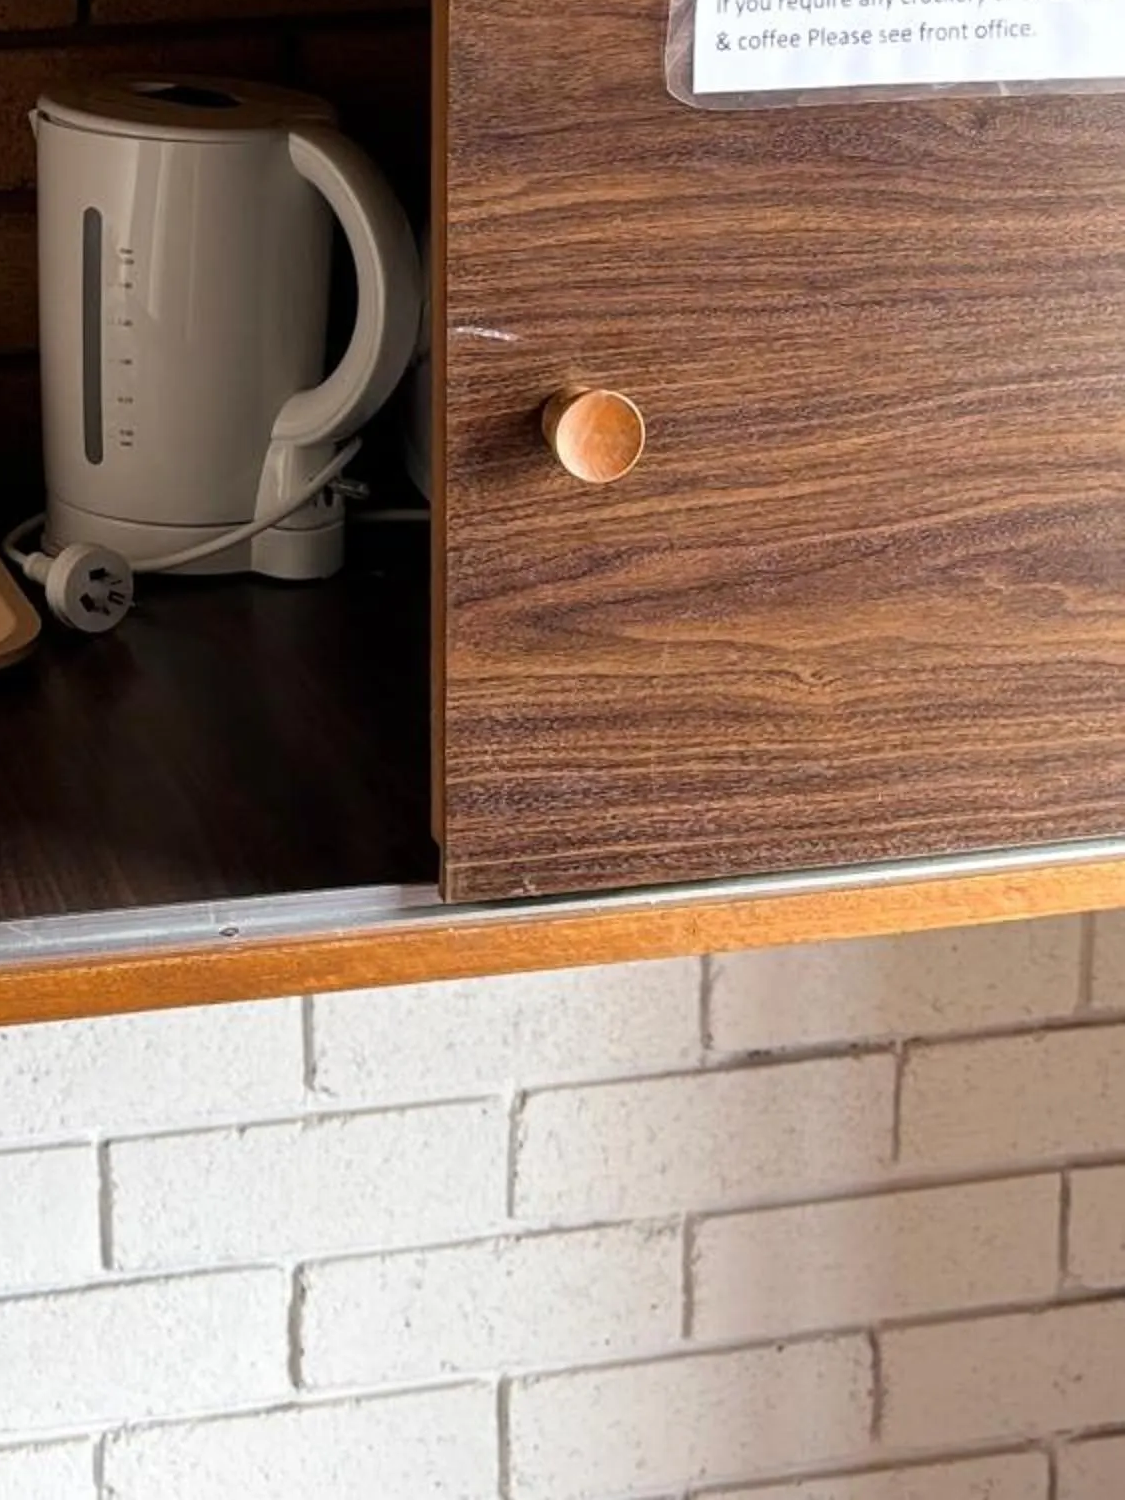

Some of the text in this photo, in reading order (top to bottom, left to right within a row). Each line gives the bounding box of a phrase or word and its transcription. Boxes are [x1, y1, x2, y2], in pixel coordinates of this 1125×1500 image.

[715, 18, 1037, 52] & coffee Please see front office.
